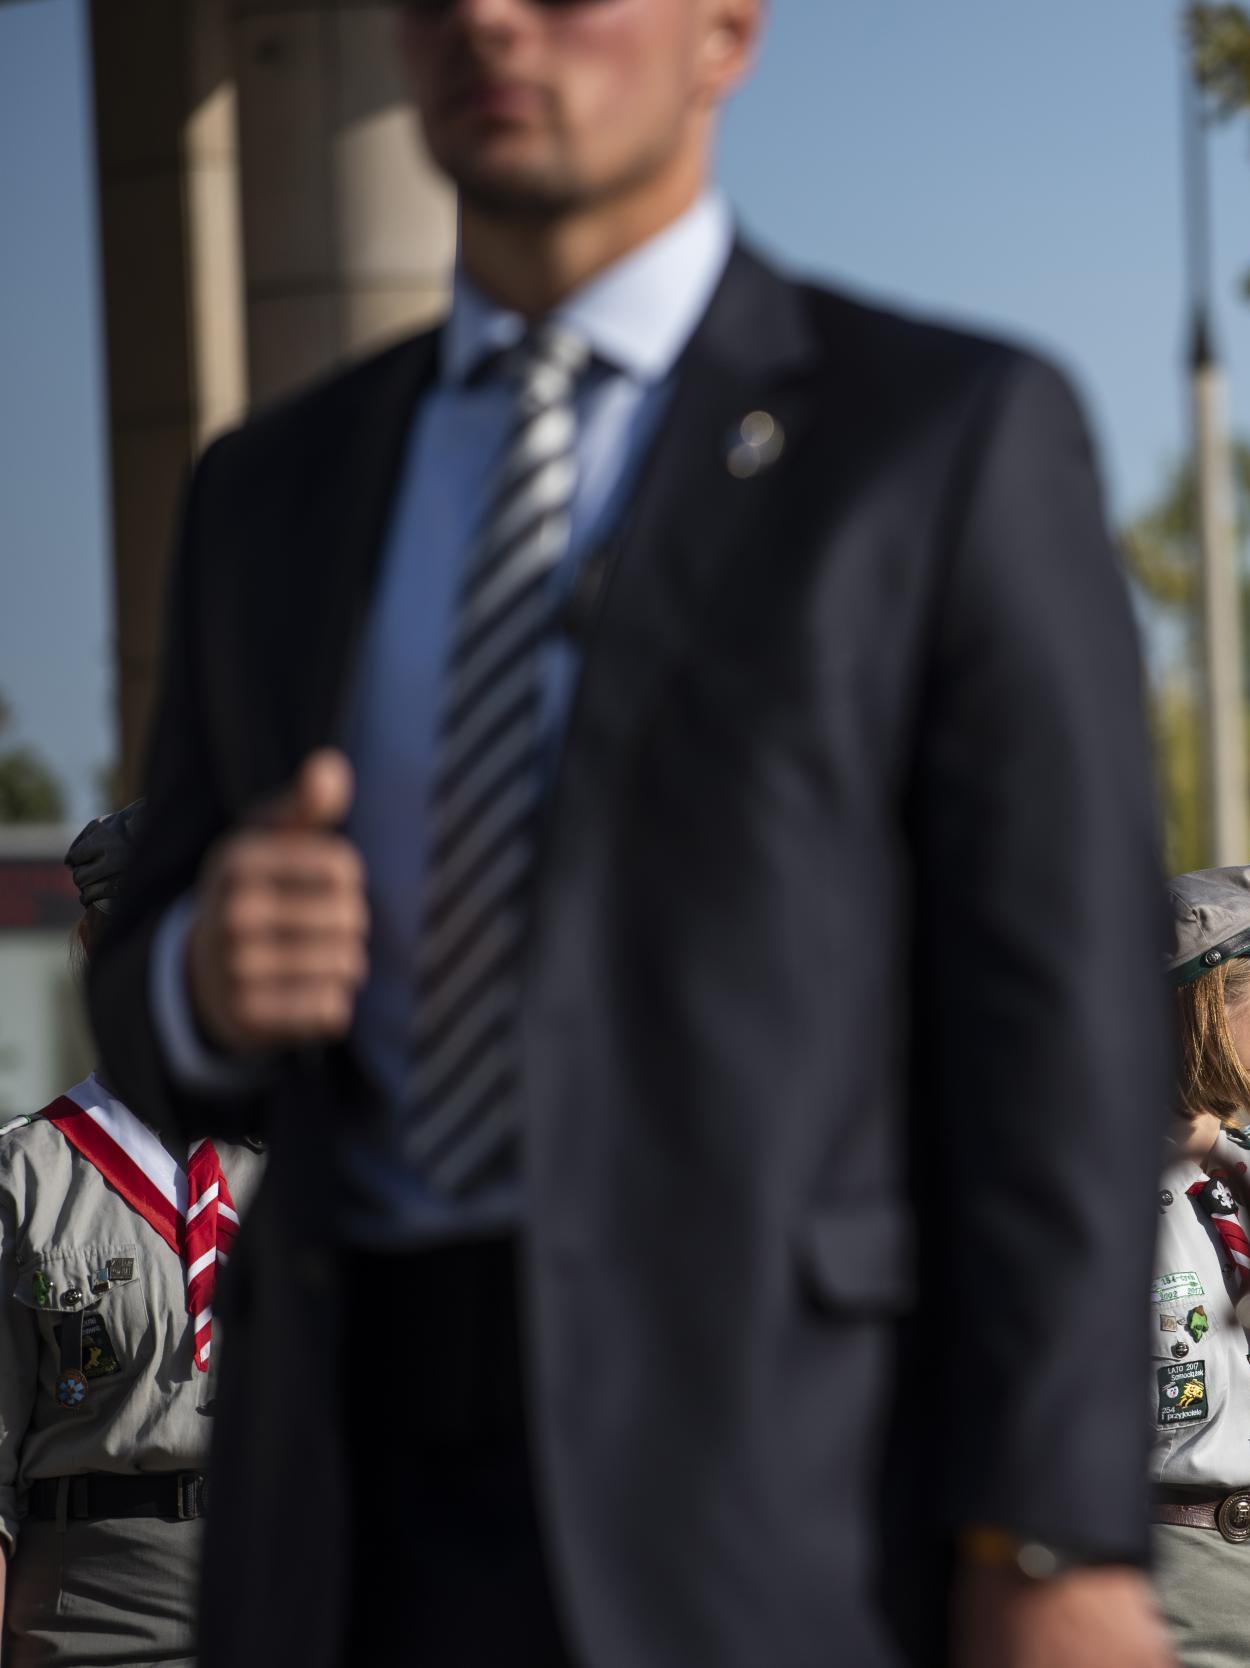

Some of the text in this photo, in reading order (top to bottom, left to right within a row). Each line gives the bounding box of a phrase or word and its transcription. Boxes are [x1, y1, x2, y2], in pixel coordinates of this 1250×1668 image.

[1167, 1362, 1199, 1375] LATO 2017
[1162, 1406, 1176, 1414] 254
